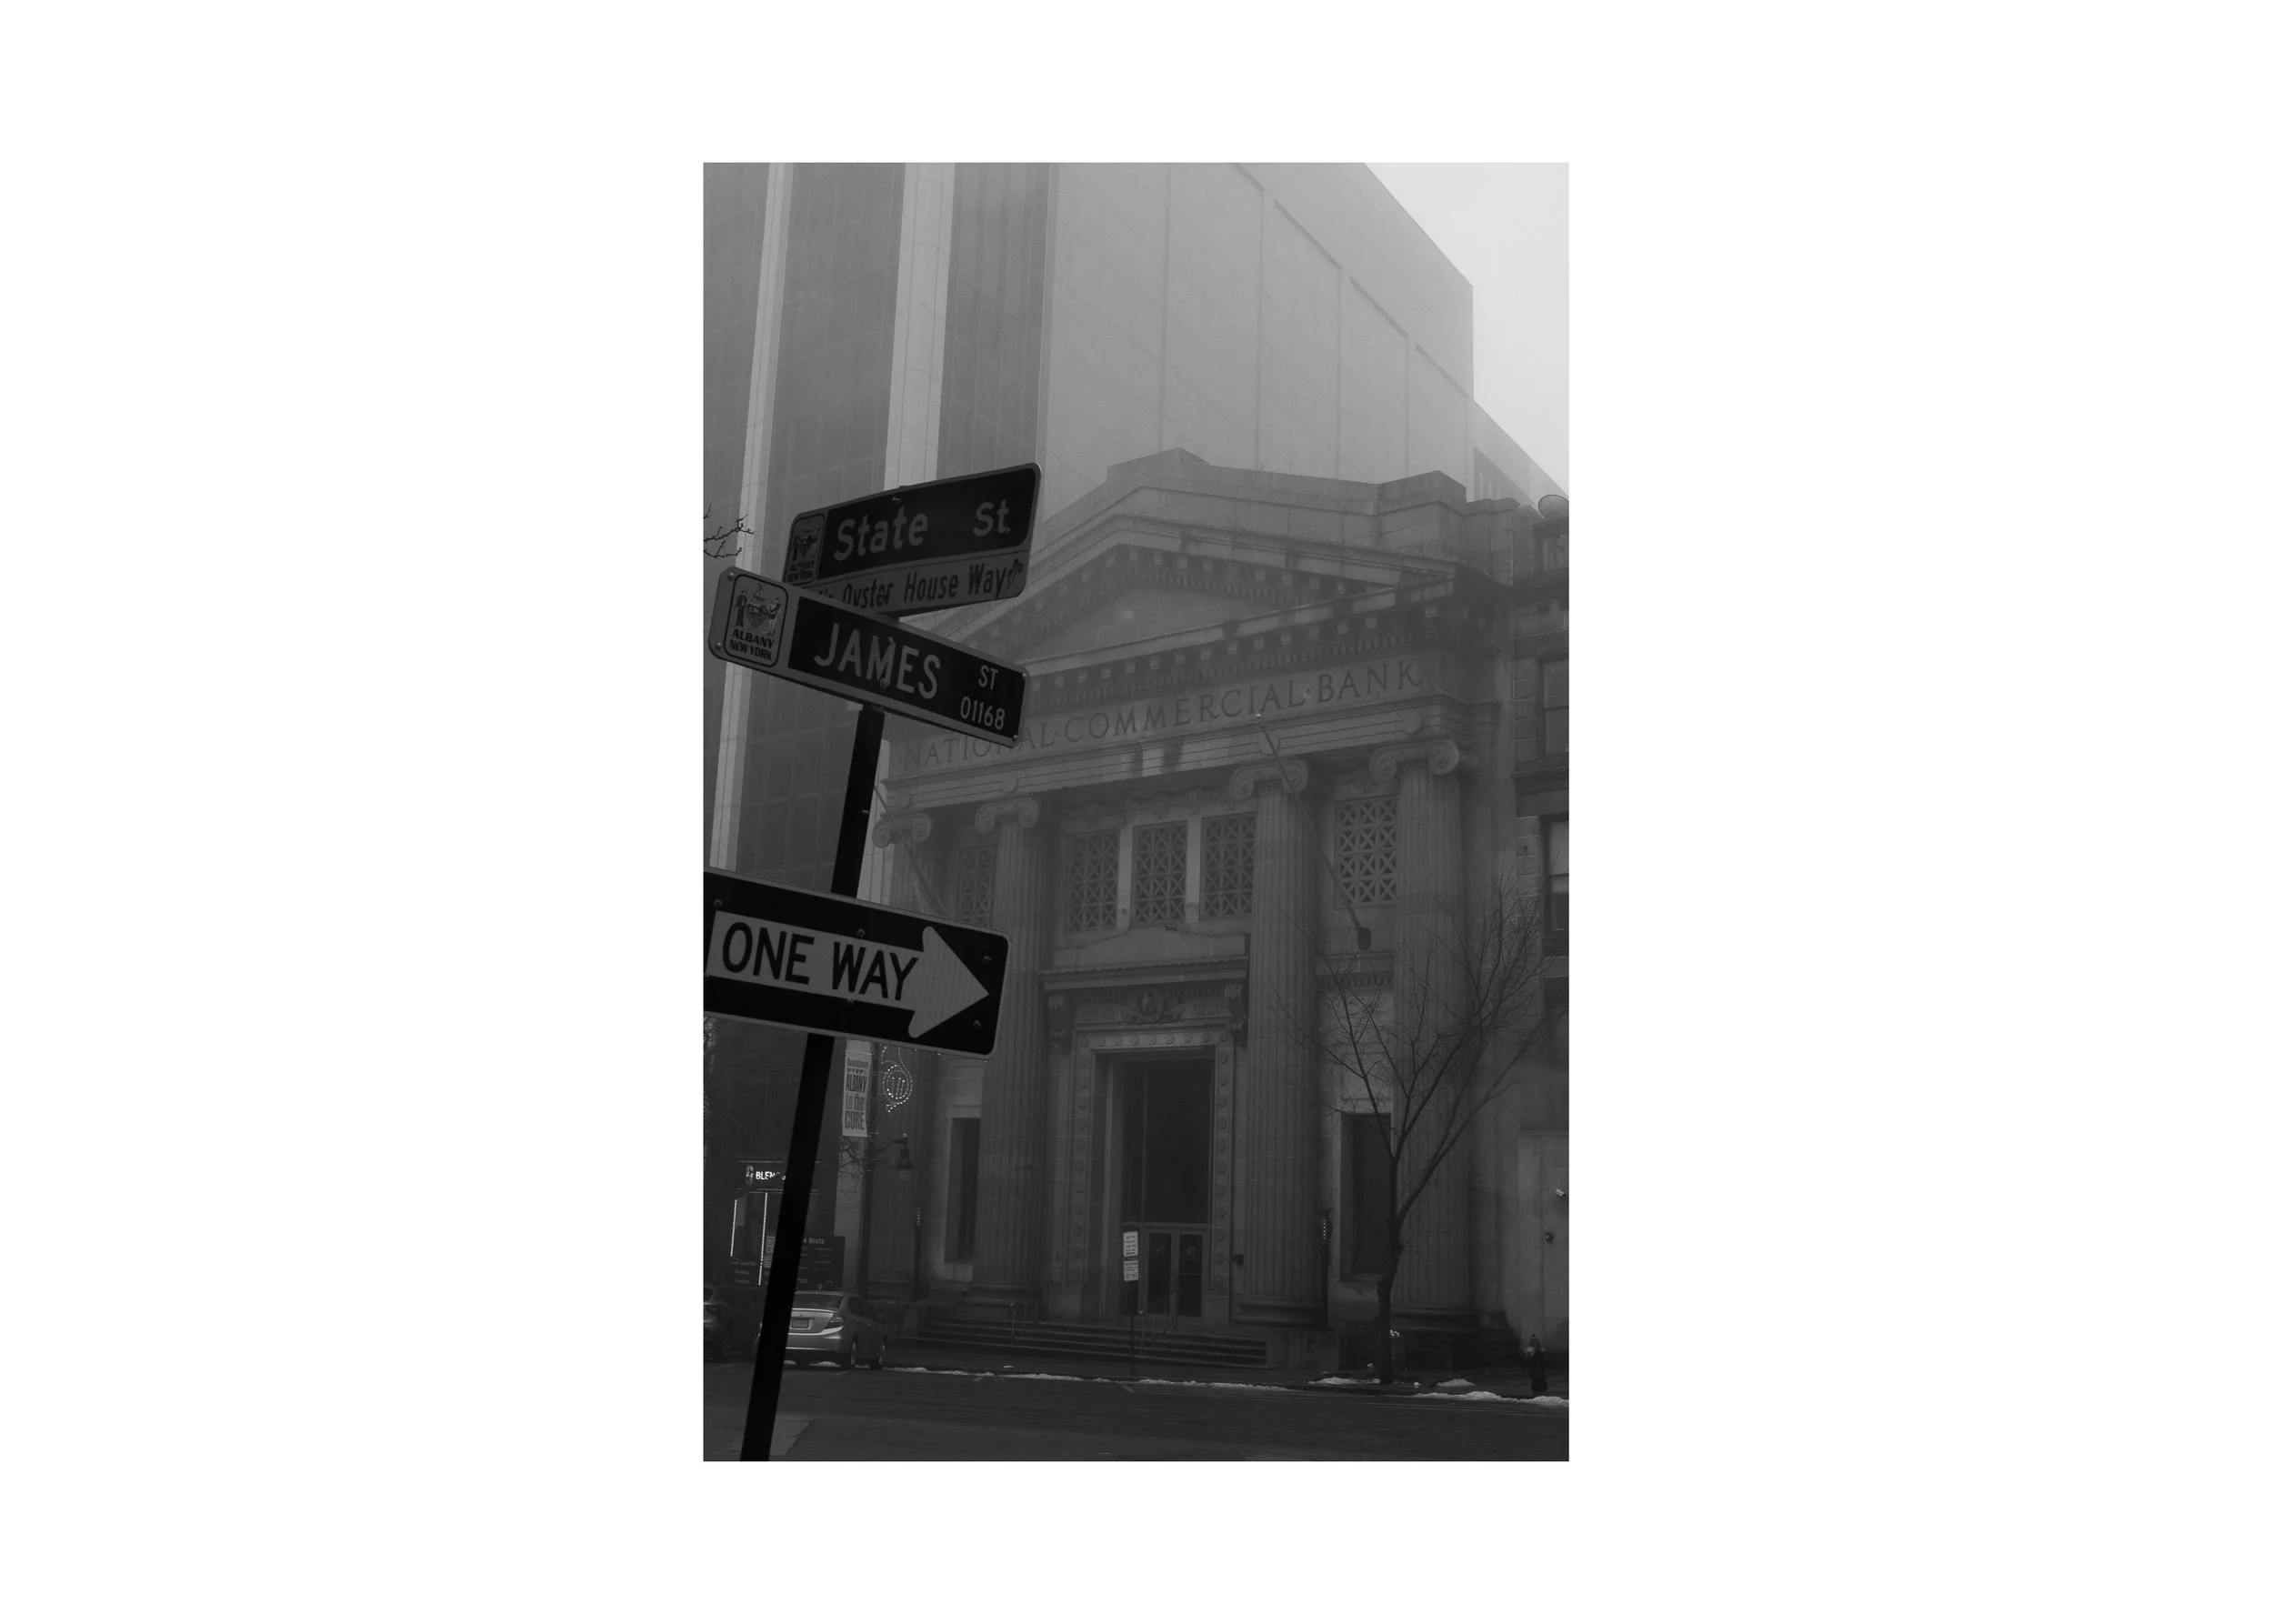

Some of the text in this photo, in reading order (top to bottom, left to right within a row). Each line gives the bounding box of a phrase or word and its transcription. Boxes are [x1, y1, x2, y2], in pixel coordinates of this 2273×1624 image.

[833, 506, 928, 562] State
[903, 571, 959, 604] House
[967, 562, 1006, 600] Way
[730, 638, 773, 661] NEW YORK
[731, 627, 775, 649] ALBANY
[813, 622, 999, 700] JAMES ST
[901, 657, 1424, 770] NATIOAL COMMERCIAL BANK
[959, 696, 1006, 731] 01168
[722, 921, 919, 1002] ONE WAY
[845, 1110, 866, 1130] CORE
